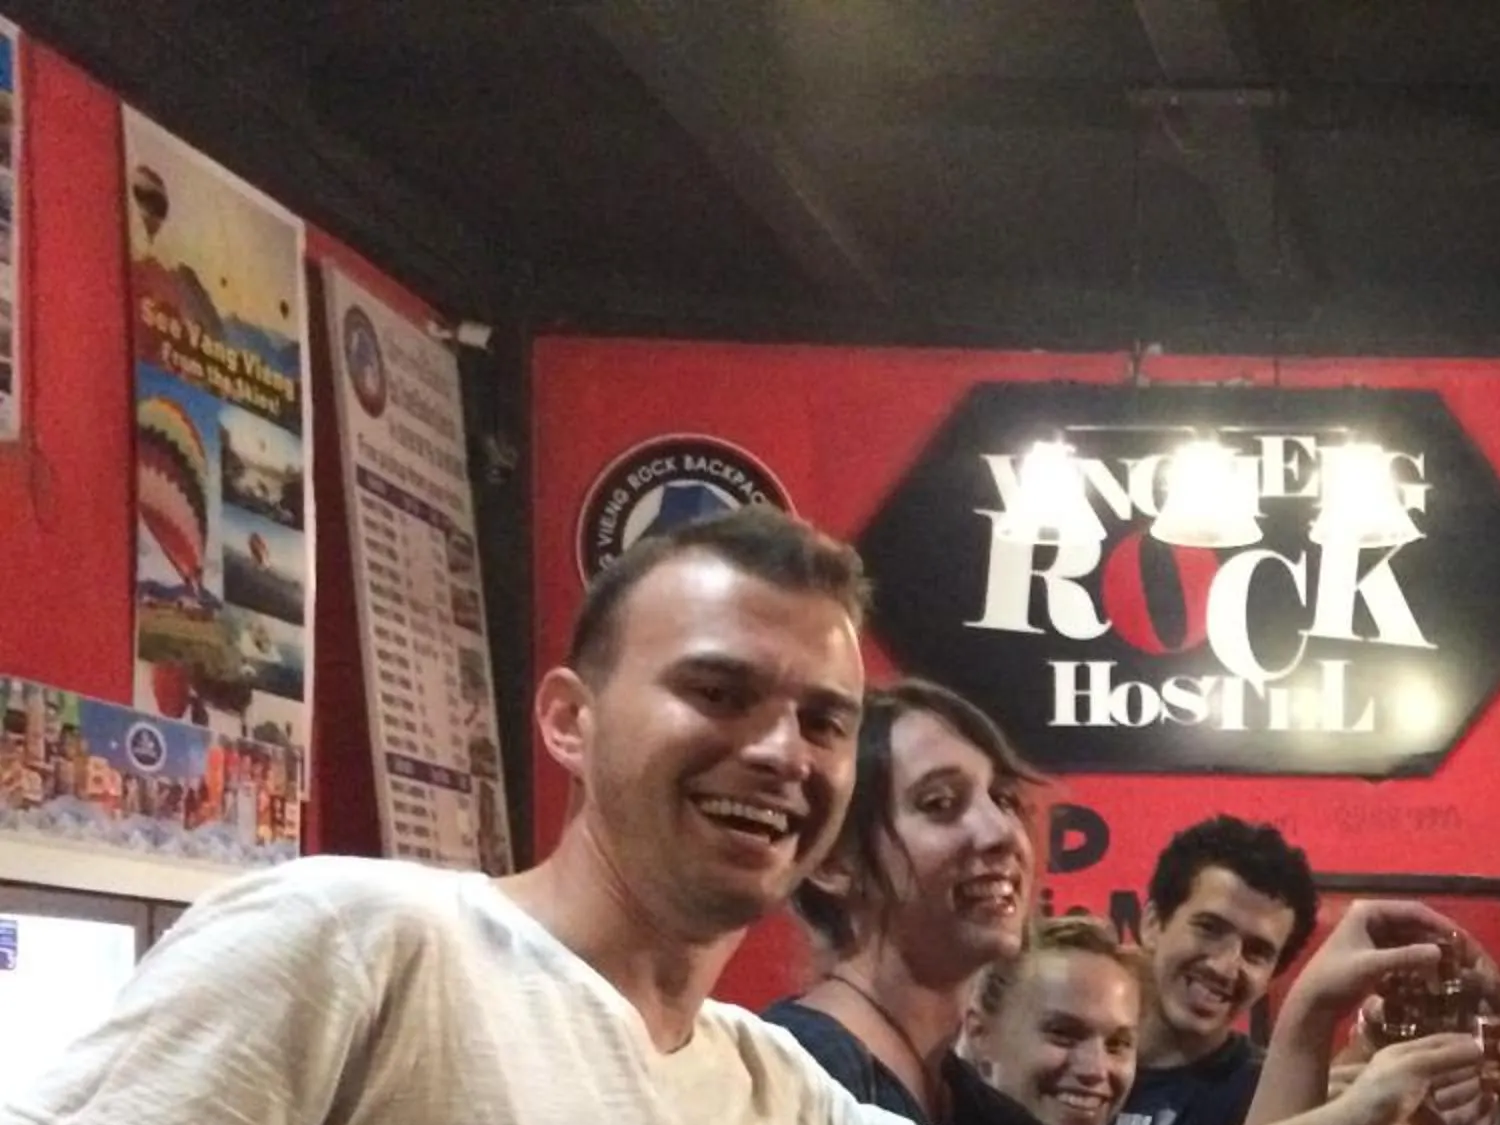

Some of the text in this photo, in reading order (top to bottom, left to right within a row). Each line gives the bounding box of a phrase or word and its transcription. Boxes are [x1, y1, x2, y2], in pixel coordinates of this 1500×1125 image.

[141, 298, 182, 340] See
[626, 456, 678, 489] ROCK
[963, 508, 1439, 698] ROCK
